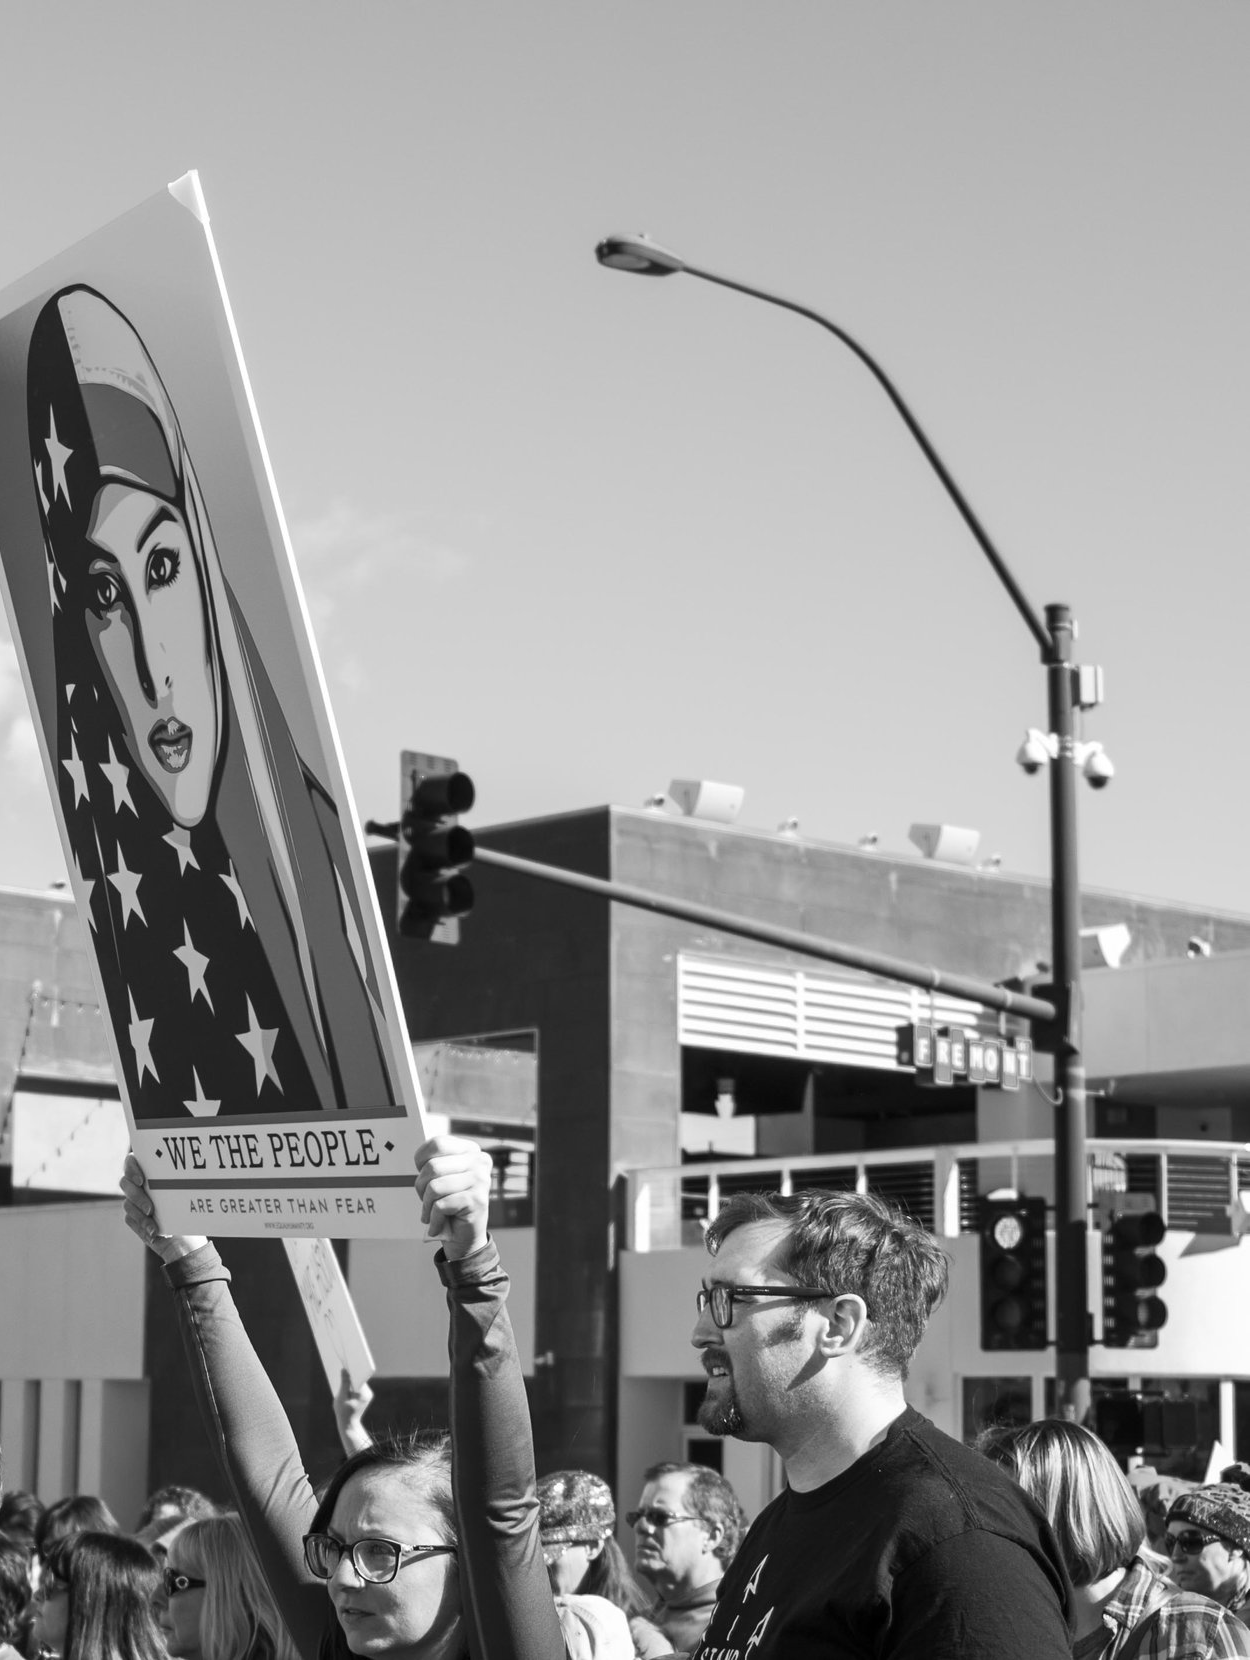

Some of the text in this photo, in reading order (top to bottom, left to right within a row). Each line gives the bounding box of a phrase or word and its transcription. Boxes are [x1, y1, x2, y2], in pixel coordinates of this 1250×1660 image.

[916, 1034, 1030, 1079] FREMONT
[162, 1128, 380, 1171] WE THE PEOPLE
[189, 1197, 377, 1214] ARE GREATER THAN FEAR
